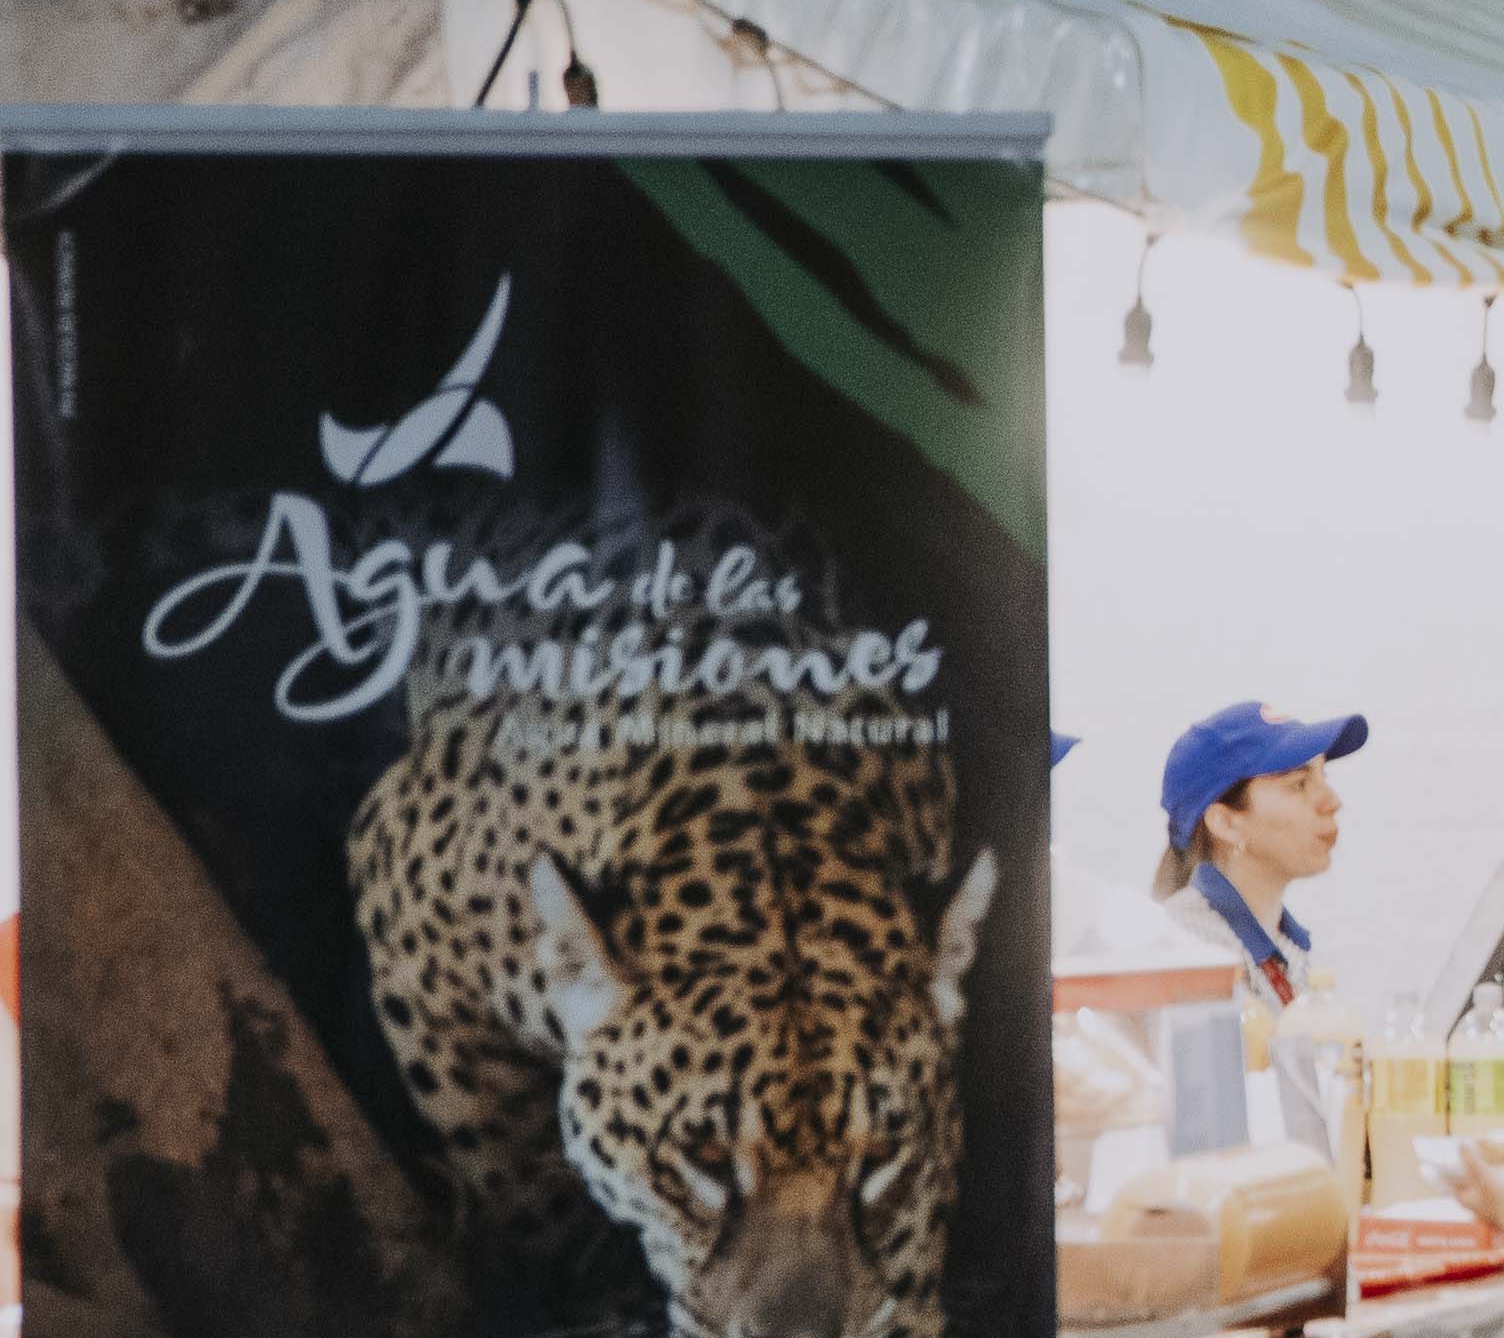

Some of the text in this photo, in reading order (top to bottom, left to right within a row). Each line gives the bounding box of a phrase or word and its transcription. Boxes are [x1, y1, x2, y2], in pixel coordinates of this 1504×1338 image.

[143, 492, 801, 721] Agua de las
[467, 617, 943, 701] misiones
[792, 707, 951, 745] Natural
